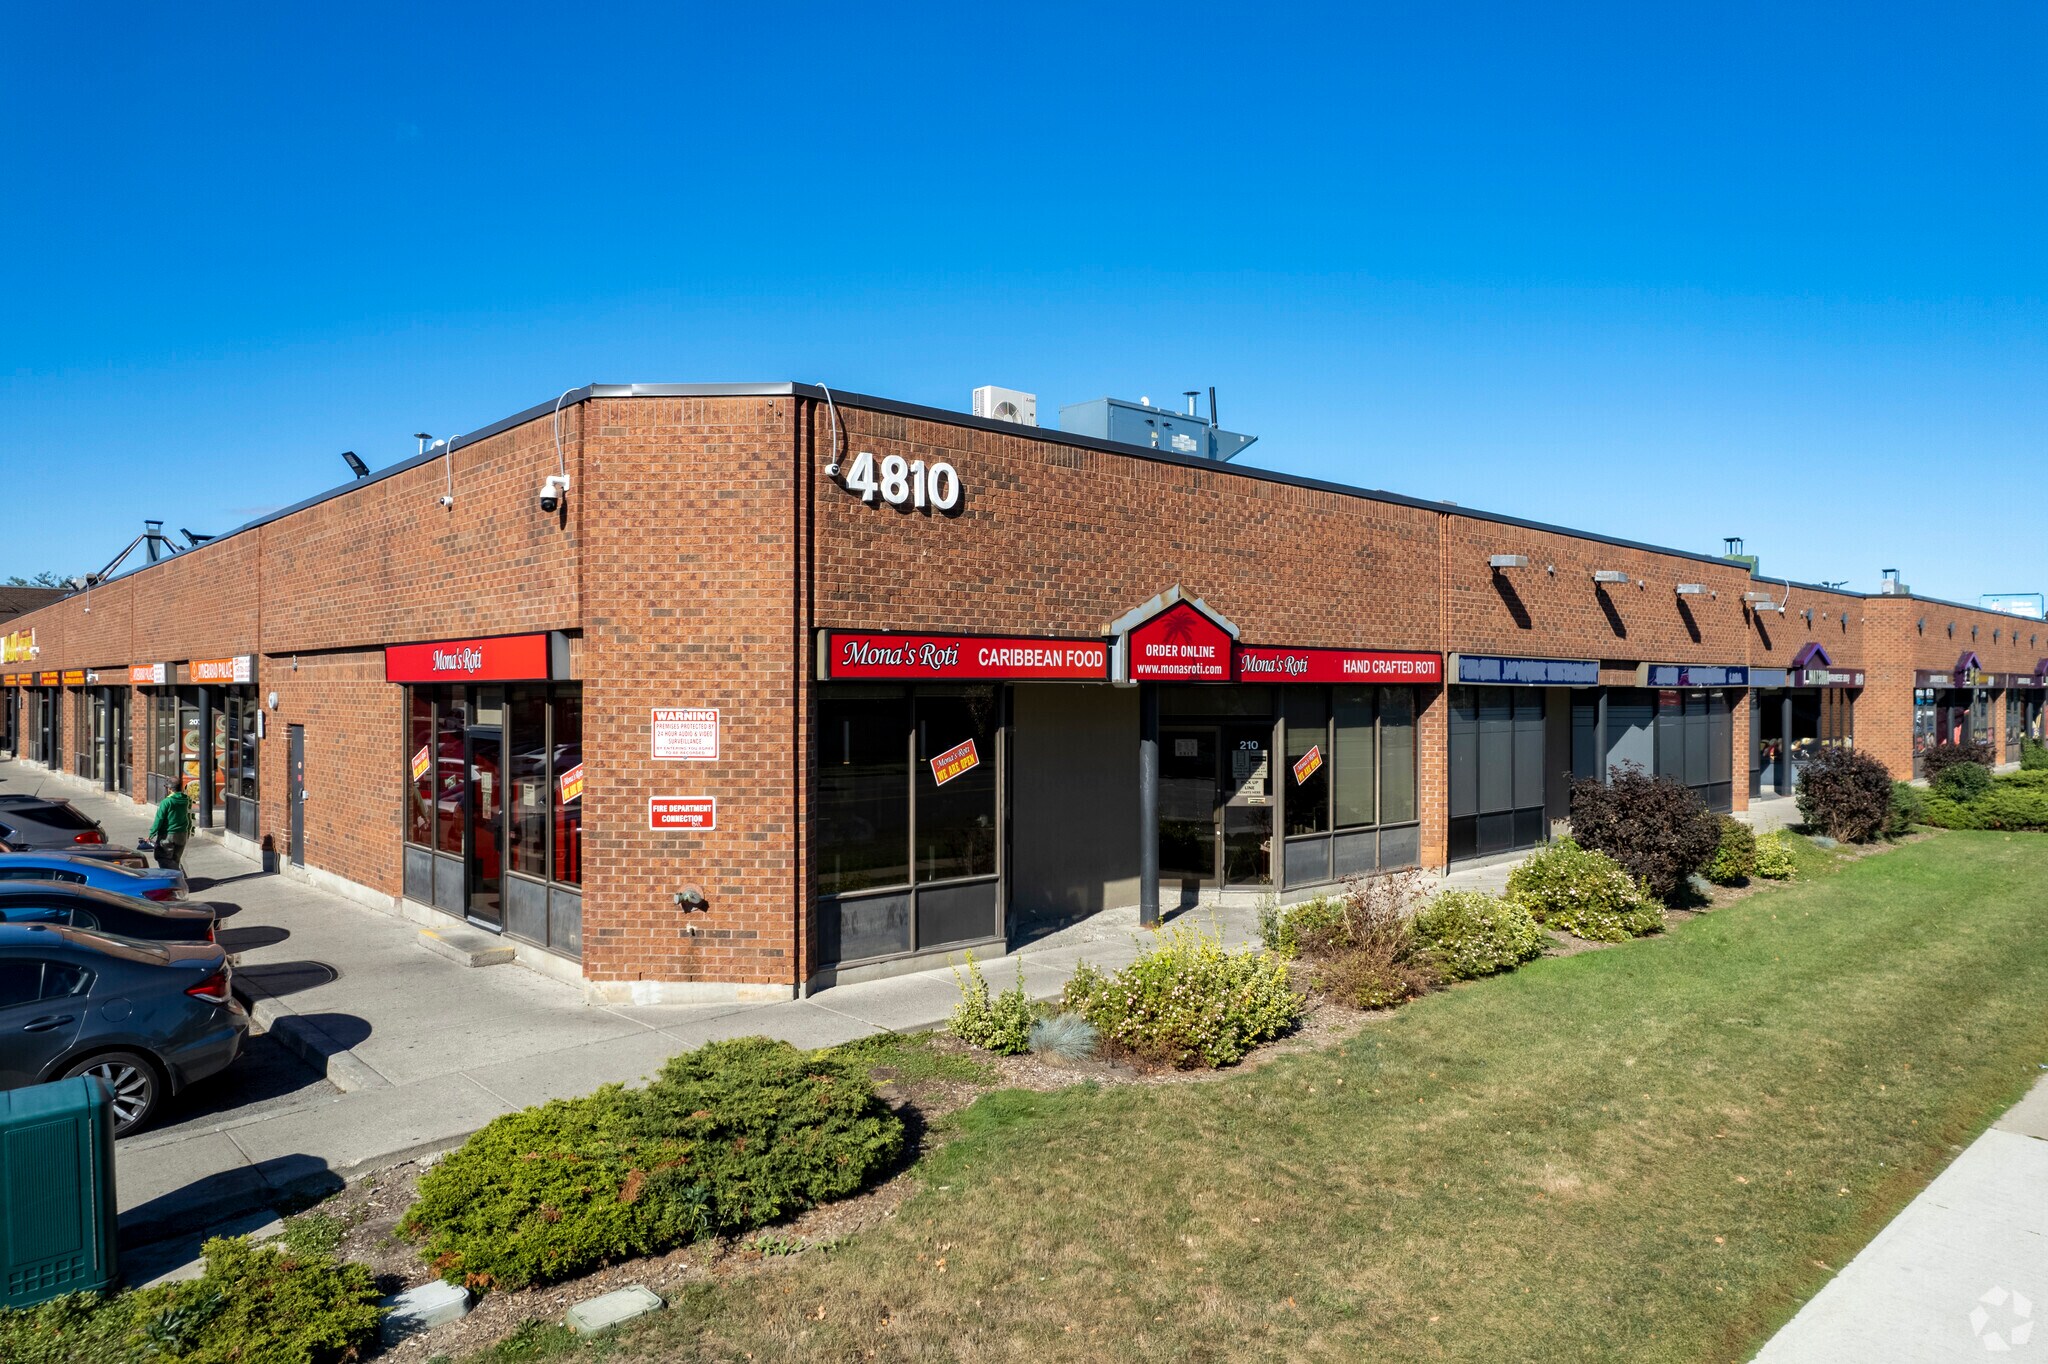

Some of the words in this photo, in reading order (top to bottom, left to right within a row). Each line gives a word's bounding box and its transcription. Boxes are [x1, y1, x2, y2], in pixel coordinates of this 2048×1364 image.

[846, 452, 959, 510] 4810
[842, 641, 916, 665] Mona's
[919, 642, 959, 670] Roti
[978, 648, 1062, 667] CARIBBEAN
[1066, 650, 1103, 667] FOOD
[1146, 644, 1178, 657] ORDER
[1181, 645, 1215, 658] ONLINE
[432, 647, 462, 671] Mona's
[463, 645, 482, 674] Roti
[1241, 654, 1284, 673] Mona's
[1285, 655, 1309, 676] Roti
[1343, 659, 1371, 674] HAND
[1372, 660, 1414, 674] CRAFTED
[1415, 661, 1435, 674] ROTI
[1137, 662, 1222, 675] www.monasroti.com
[655, 711, 715, 721] WARNING
[1240, 741, 1258, 750] 210
[936, 768, 948, 782] WE
[948, 761, 961, 776] ARE
[960, 753, 976, 769] OPEN
[652, 804, 668, 813] FIRE
[668, 804, 712, 813] DEPARTMENT
[661, 814, 703, 823] CONNECTION
